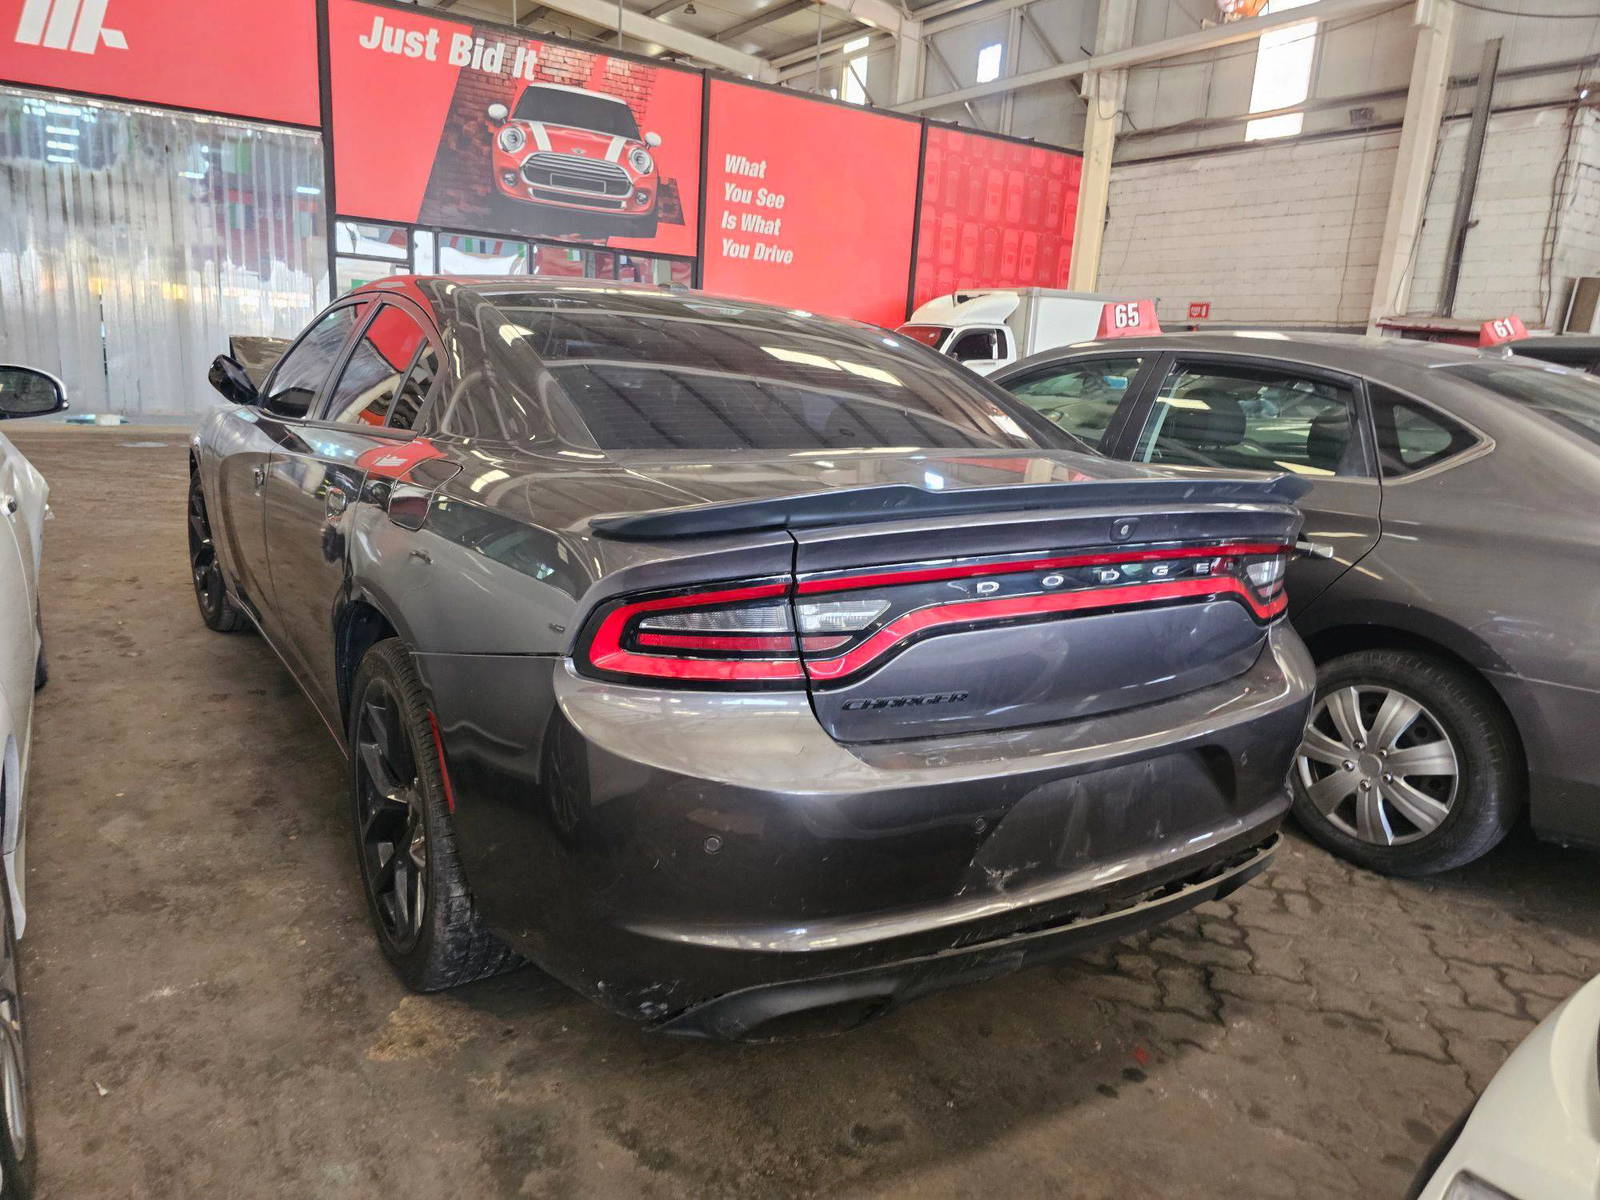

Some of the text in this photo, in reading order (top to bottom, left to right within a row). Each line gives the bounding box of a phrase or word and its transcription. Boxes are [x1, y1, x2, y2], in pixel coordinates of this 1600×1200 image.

[359, 16, 538, 81] Just Bid It
[725, 153, 767, 179] What
[724, 182, 785, 209] You See
[721, 210, 782, 236] Is What
[721, 238, 794, 264] You Drive
[1114, 302, 1140, 329] 65
[1492, 317, 1516, 337] 61
[976, 562, 1210, 594] DODGE
